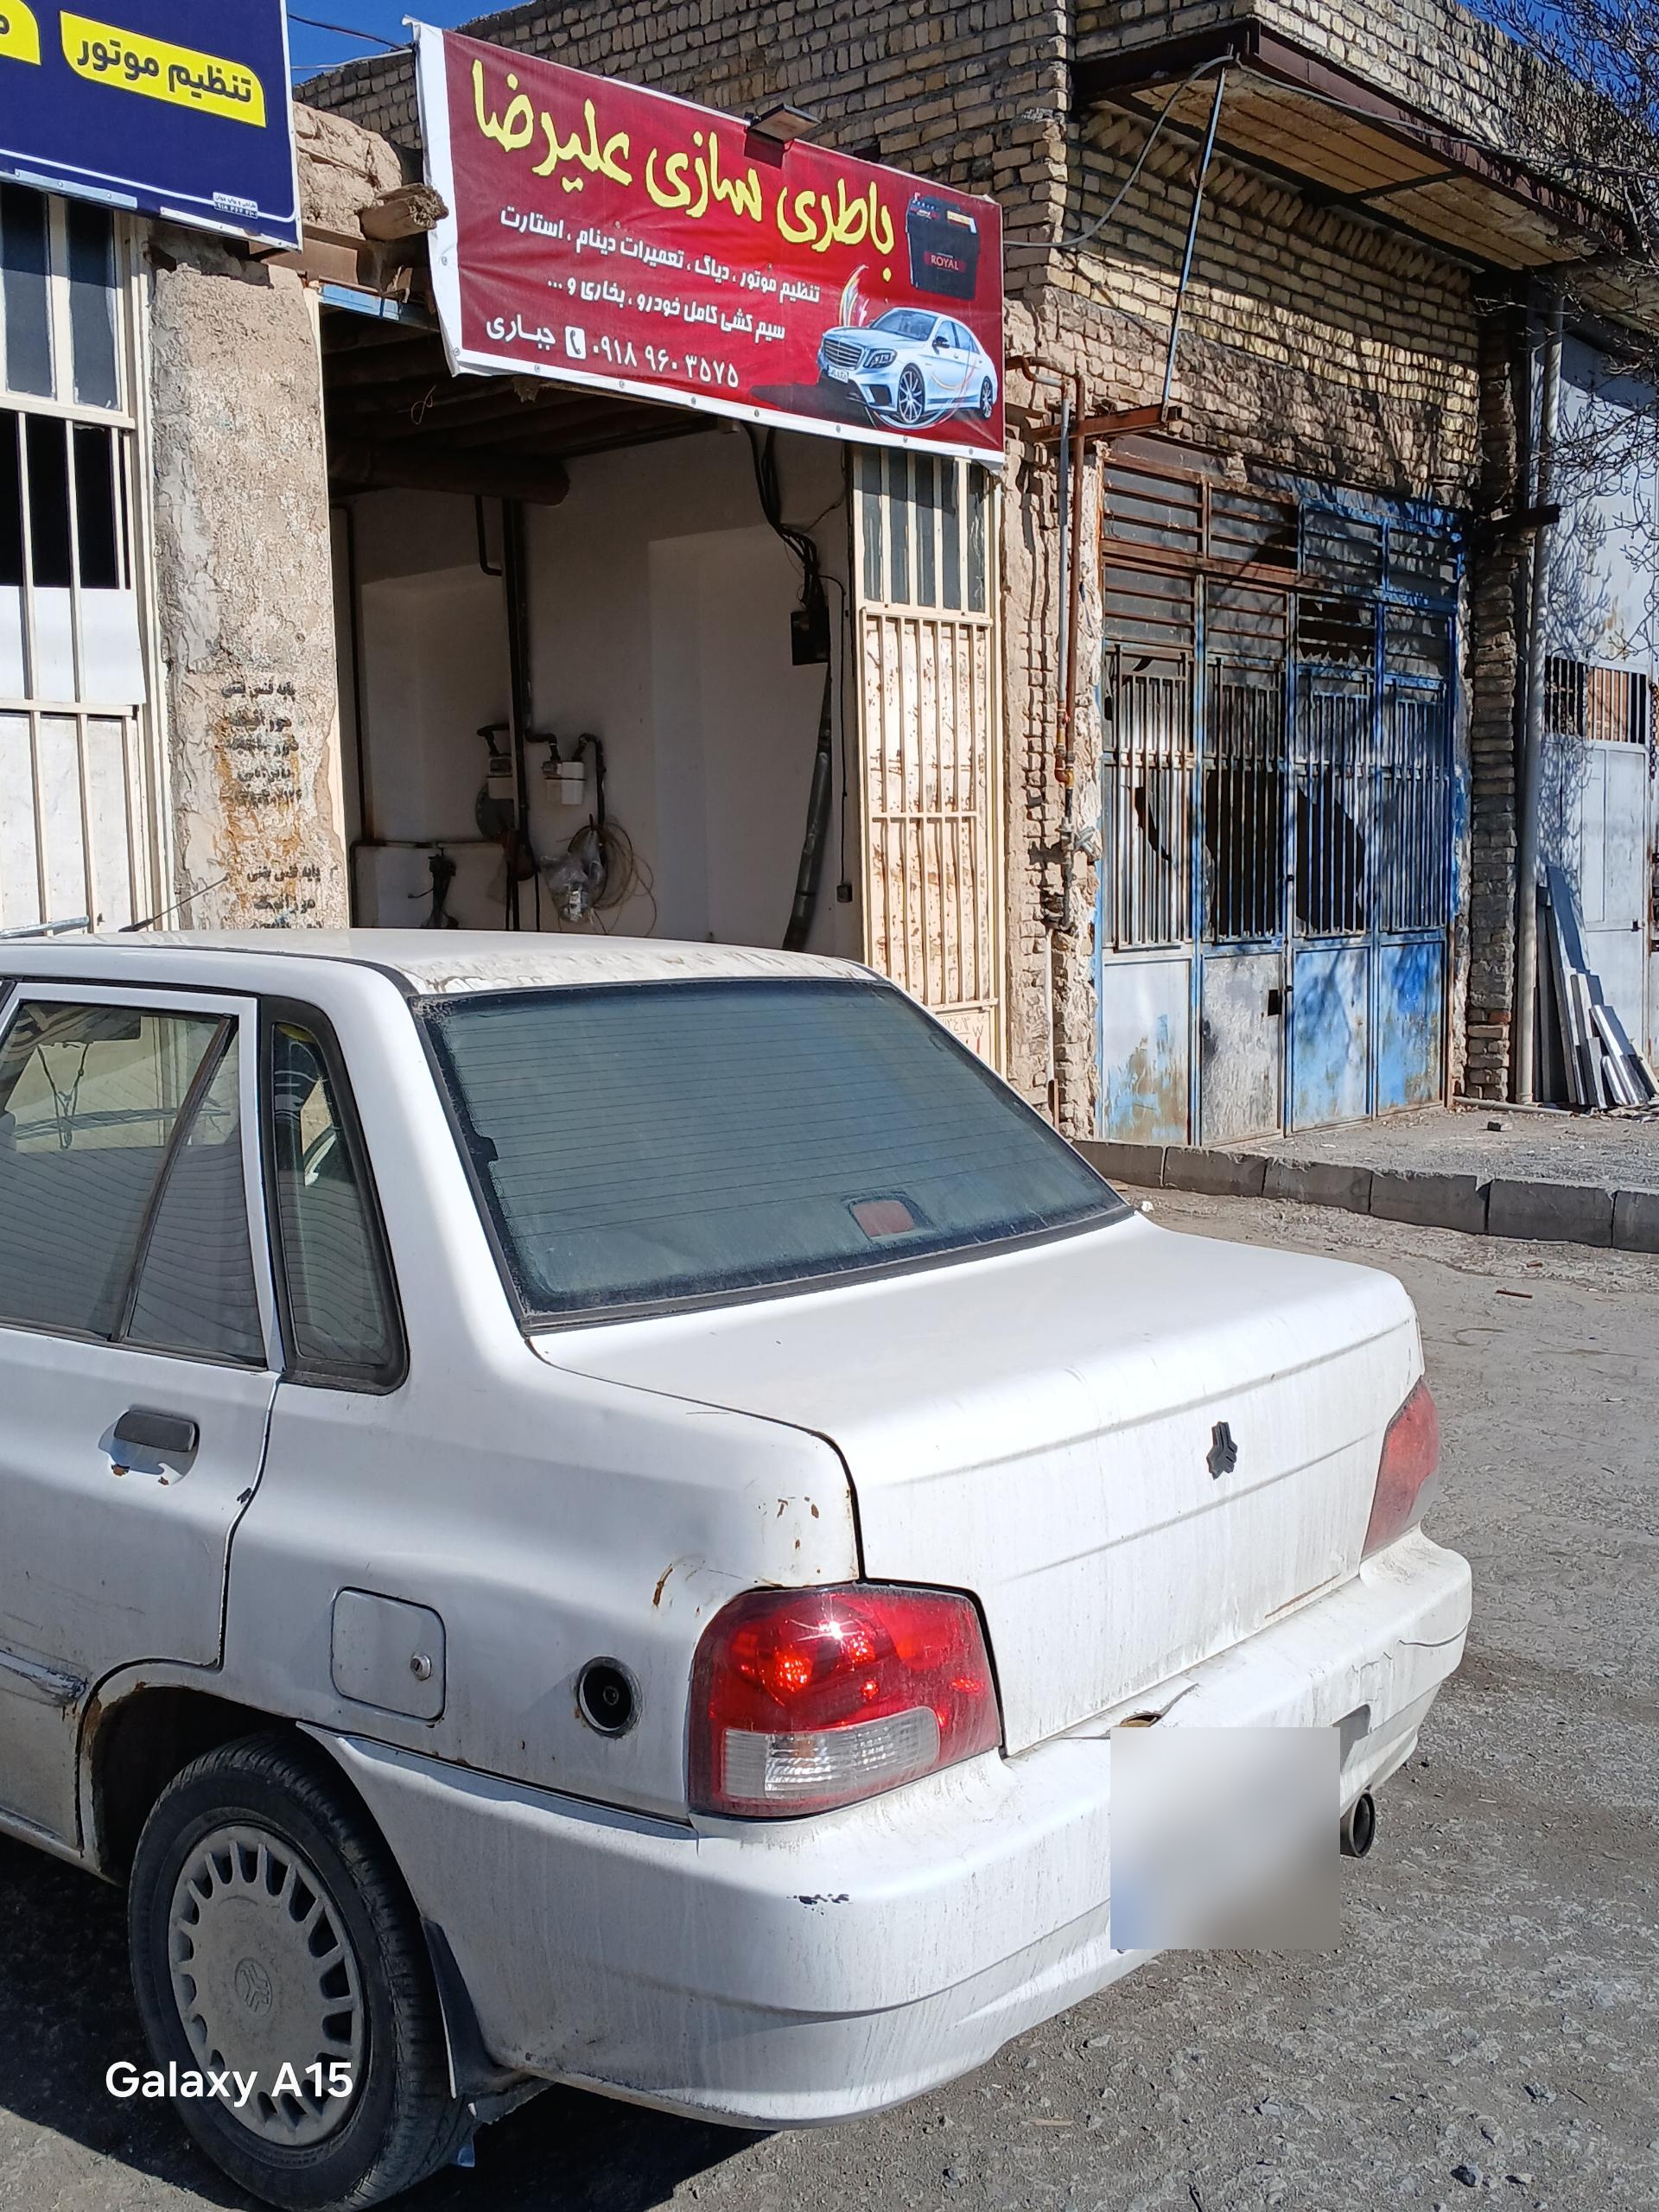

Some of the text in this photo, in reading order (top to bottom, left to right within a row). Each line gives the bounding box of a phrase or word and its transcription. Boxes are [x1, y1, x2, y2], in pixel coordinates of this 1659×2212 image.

[77, 40, 251, 102] تنظیم موتور
[472, 59, 895, 282] باطری سازی علیرضا
[500, 205, 564, 239] استارت
[575, 227, 616, 256] دینام
[620, 236, 685, 268] تعمیرات
[694, 254, 729, 284] دیاگ
[931, 254, 959, 270] ROYAL
[567, 277, 576, 296] و
[580, 280, 626, 308] بخاری
[740, 270, 777, 294] موتور
[779, 281, 820, 304] تنظیم
[637, 296, 681, 317] خودرو
[683, 301, 717, 325] کامل
[721, 308, 753, 332] کشی
[754, 321, 785, 344] سیم
[486, 315, 739, 388] ۰۹۱۸ ۹۶۰ ۳۵۷۵ جباری
